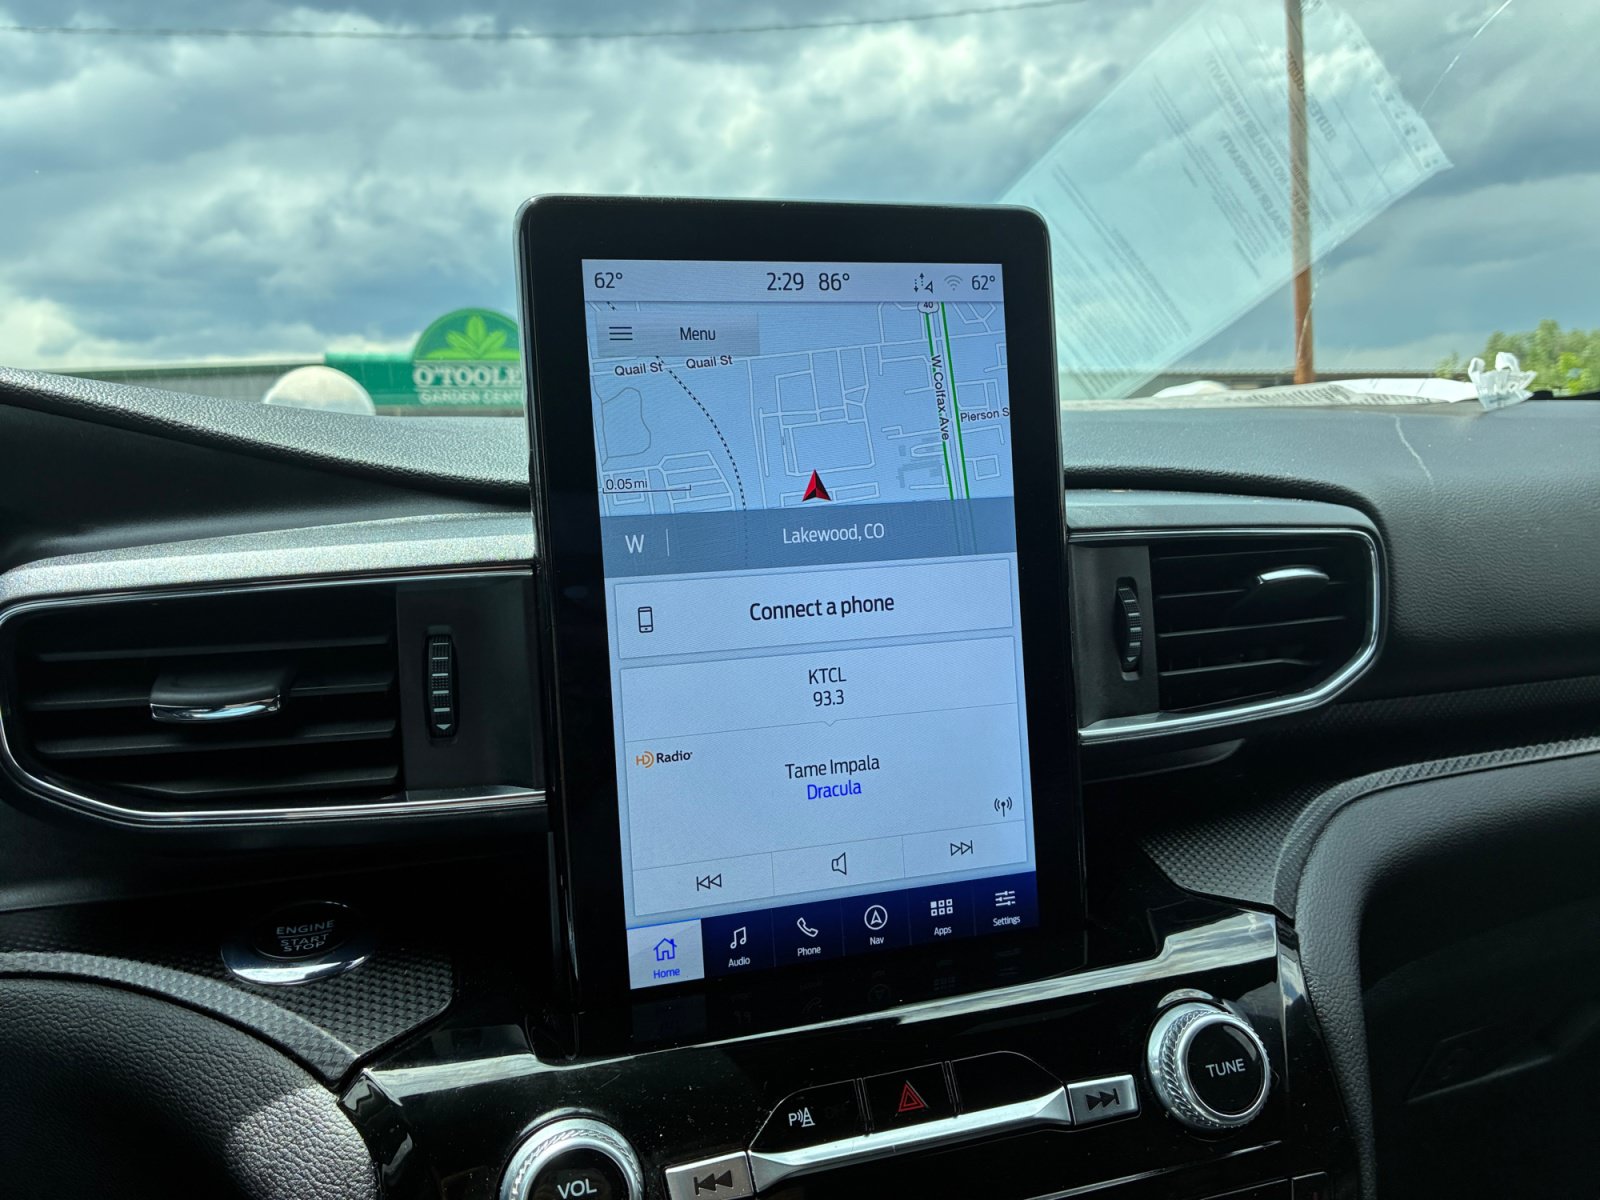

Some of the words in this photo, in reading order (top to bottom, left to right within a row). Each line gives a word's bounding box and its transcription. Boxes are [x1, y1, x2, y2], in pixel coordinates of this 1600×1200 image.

[594, 271, 623, 289] 62°
[766, 272, 804, 291] 2:29
[818, 272, 850, 291] 86°
[971, 274, 996, 290] 62°
[679, 326, 717, 341] Menu
[614, 363, 647, 377] Quail
[650, 361, 664, 374] St
[686, 355, 717, 369] Quail
[720, 354, 733, 366] St
[421, 388, 480, 404] GARDEN
[933, 371, 947, 413] Colfax
[960, 409, 1000, 423] Pierson
[939, 415, 950, 441] Ave
[605, 478, 633, 491] 0.05
[783, 523, 862, 545] Lakewood,
[864, 522, 885, 539] CO
[625, 534, 645, 554] W
[750, 600, 823, 621] Connect
[826, 601, 837, 616] a
[840, 596, 895, 618] phone
[808, 667, 847, 685] KTCL
[813, 689, 845, 707] 93.3
[785, 762, 827, 779] Tame
[830, 755, 880, 774] Impala
[807, 779, 862, 800] Dracula
[276, 920, 334, 935] ENGINE
[993, 915, 1021, 926] Settings
[934, 927, 952, 936] Apps
[281, 933, 329, 947] START
[283, 941, 325, 952] STOP
[869, 936, 885, 946] Nav
[797, 946, 822, 957] Phone
[728, 956, 750, 967] Audio
[653, 967, 680, 979] Home
[1205, 1058, 1246, 1078] TUNE
[557, 1178, 597, 1199] VOL
